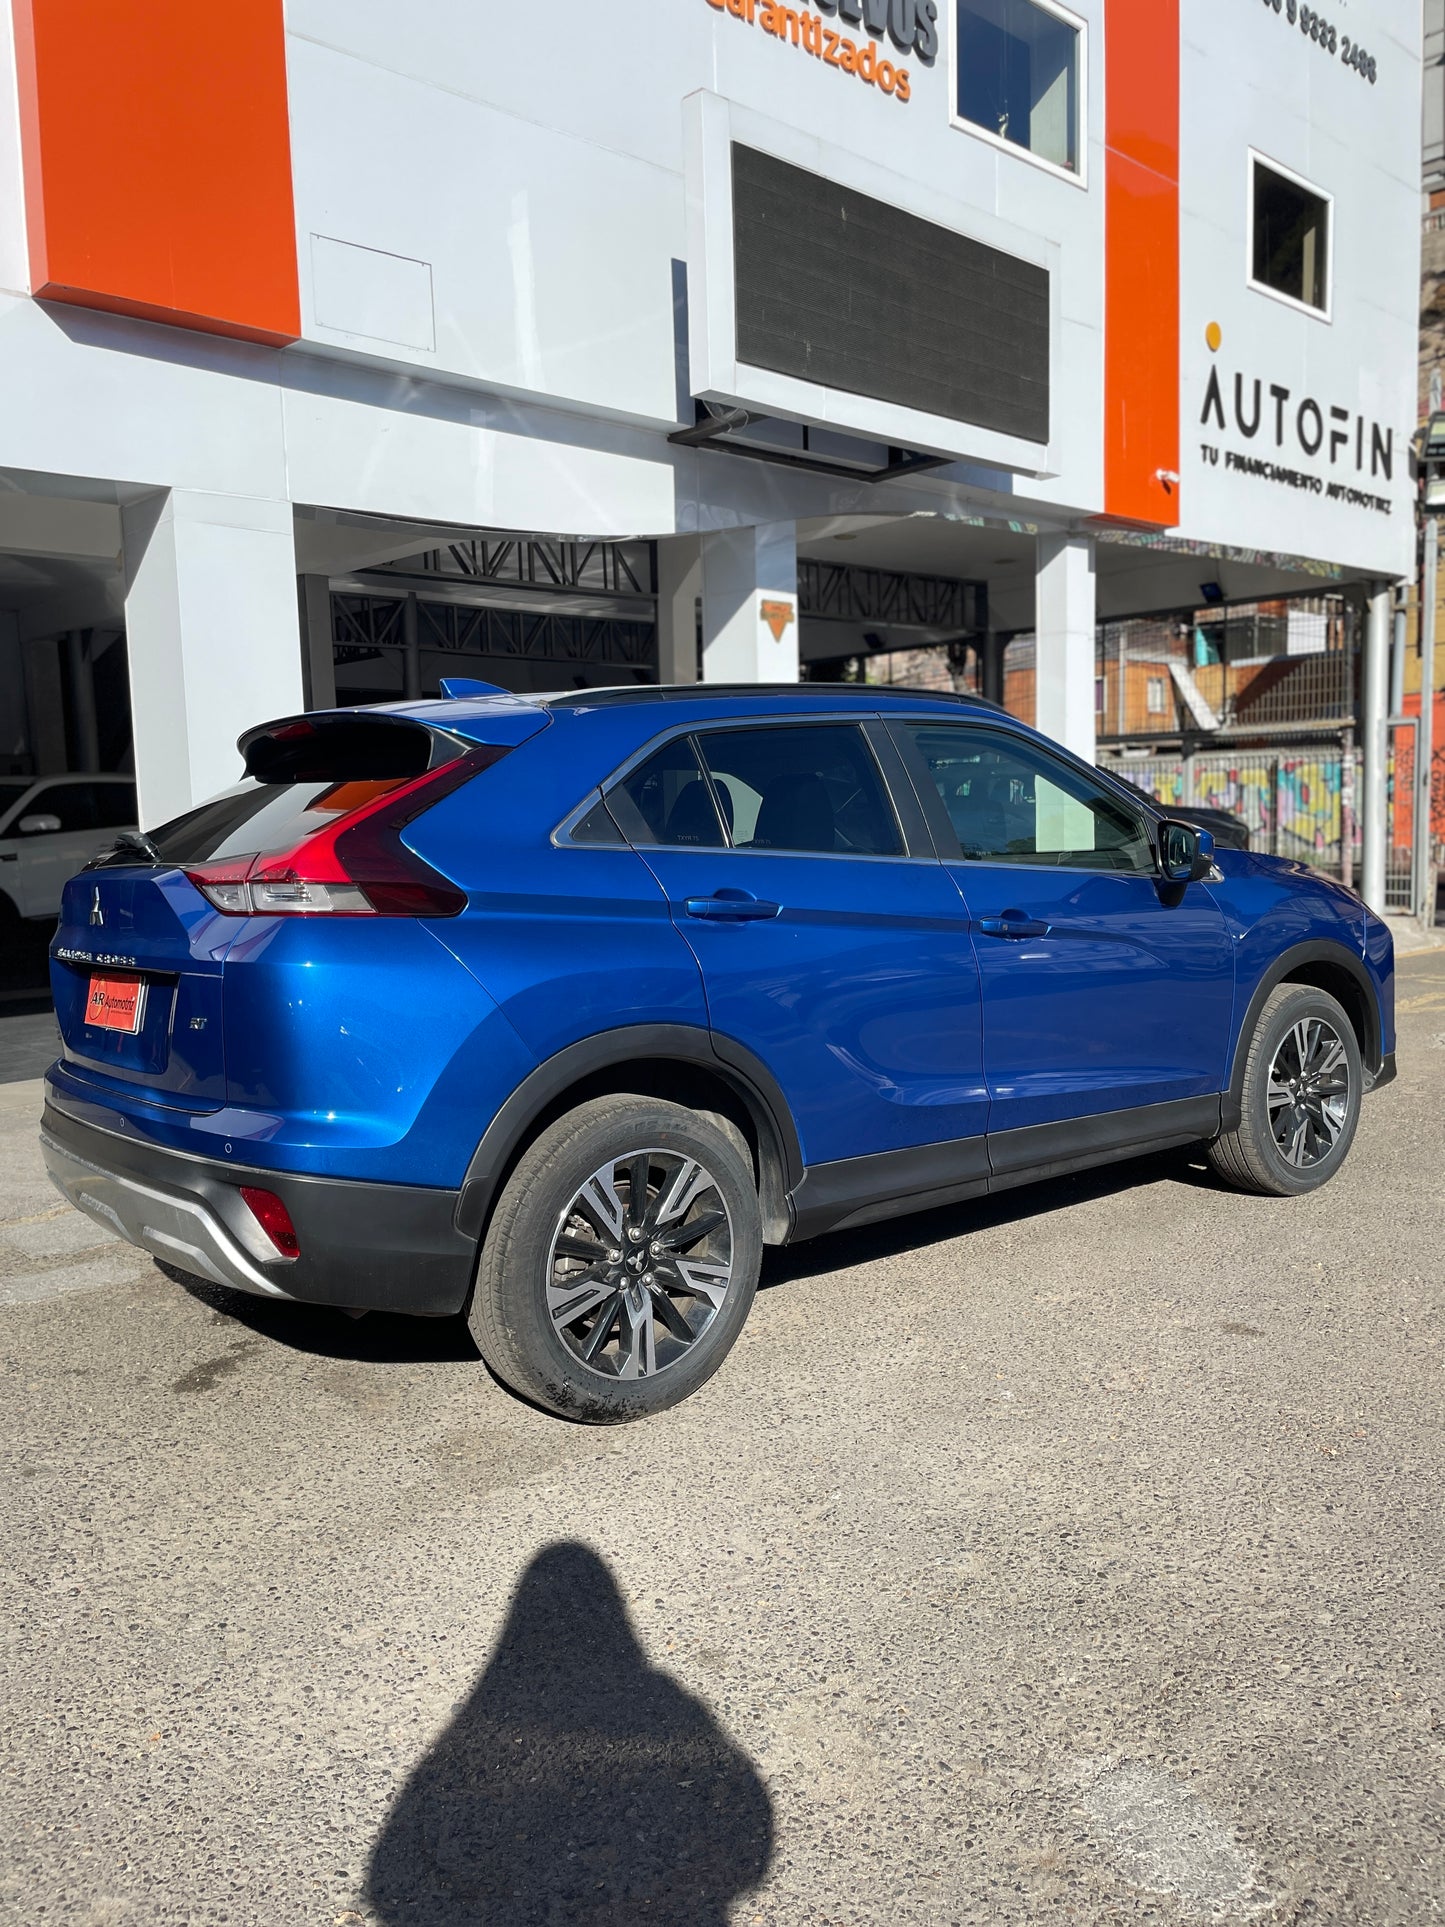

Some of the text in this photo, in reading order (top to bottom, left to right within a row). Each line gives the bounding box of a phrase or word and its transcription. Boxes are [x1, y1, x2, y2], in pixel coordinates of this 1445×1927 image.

[705, 0, 910, 101] arantizados
[1200, 363, 1393, 482] AUTOFIN
[1200, 444, 1392, 515] TU FINANCIAMIENTO AUTOMOTRIZ
[91, 992, 134, 1011] AR Automotriz
